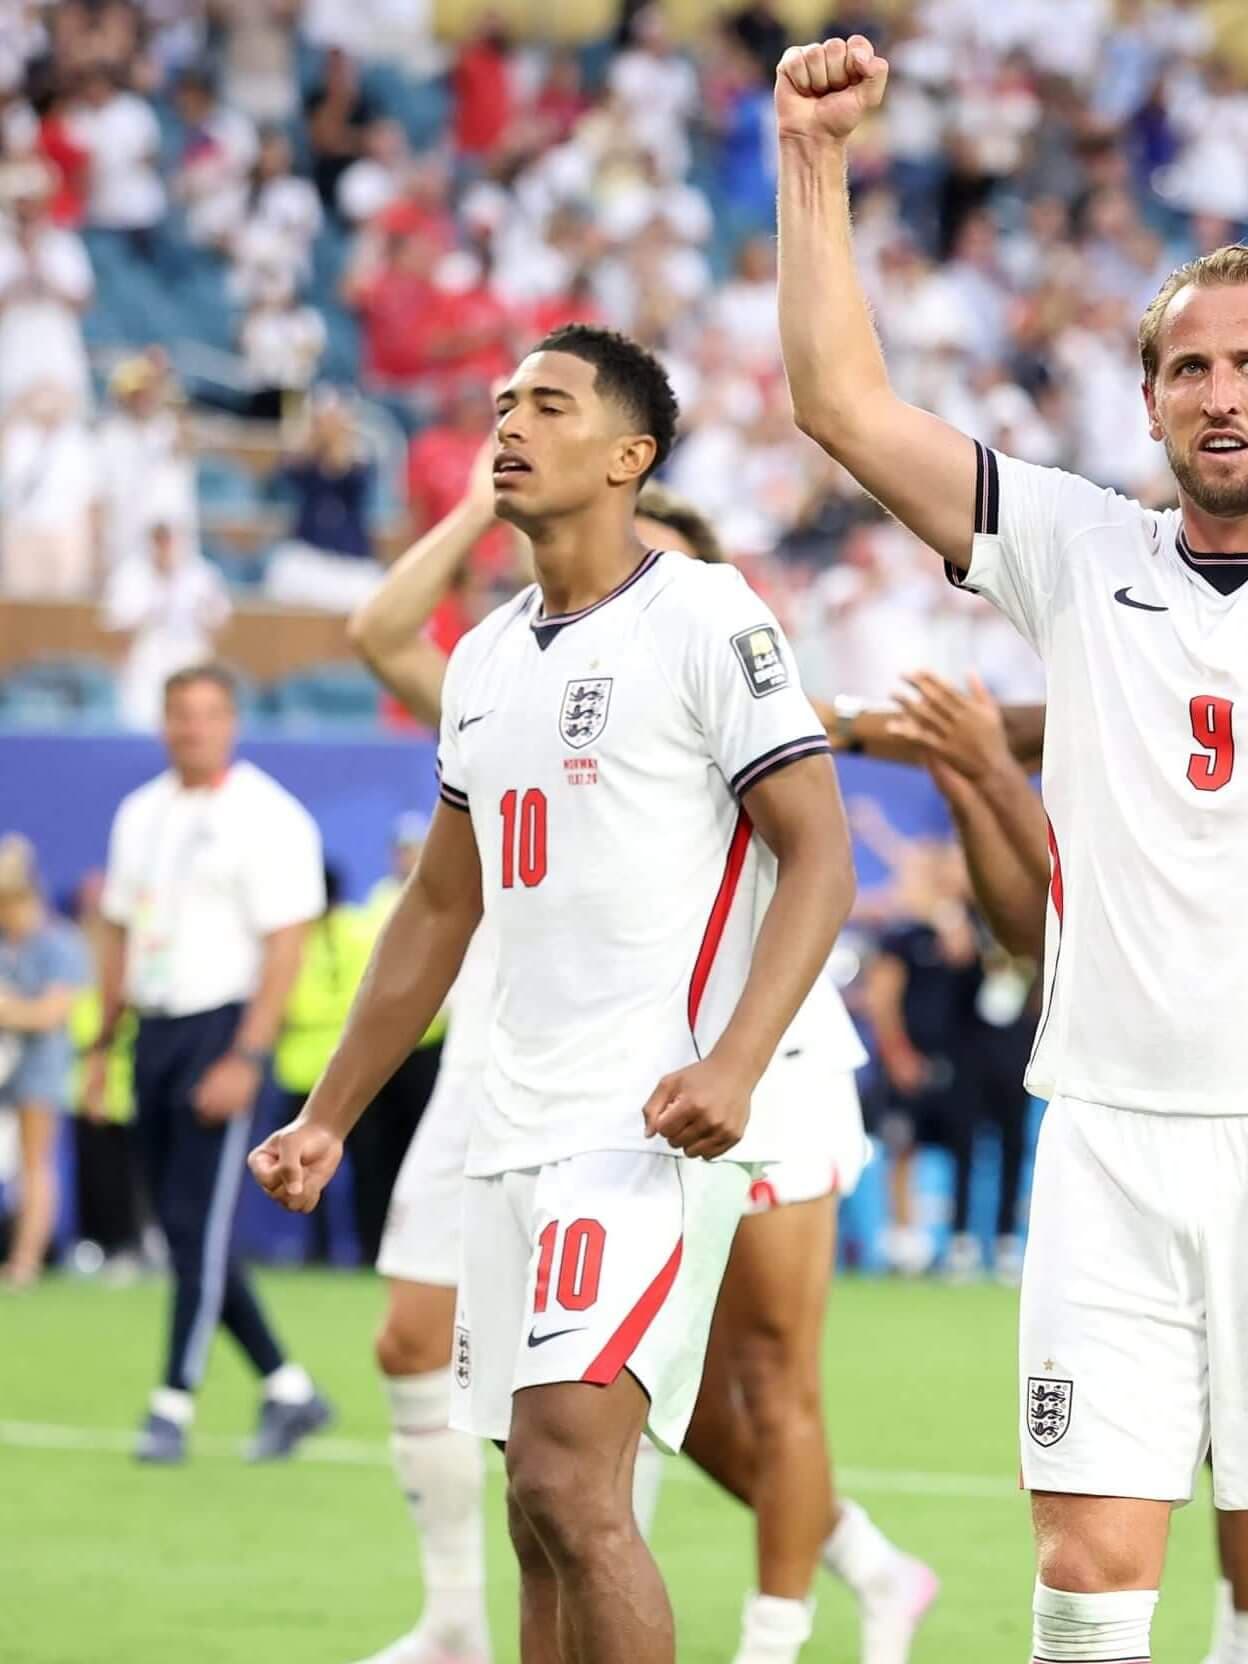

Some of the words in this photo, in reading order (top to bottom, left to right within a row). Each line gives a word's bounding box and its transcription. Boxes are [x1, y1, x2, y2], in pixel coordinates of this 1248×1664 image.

[1187, 693, 1236, 792] 9
[499, 788, 548, 889] 10
[533, 1218, 607, 1314] 10
